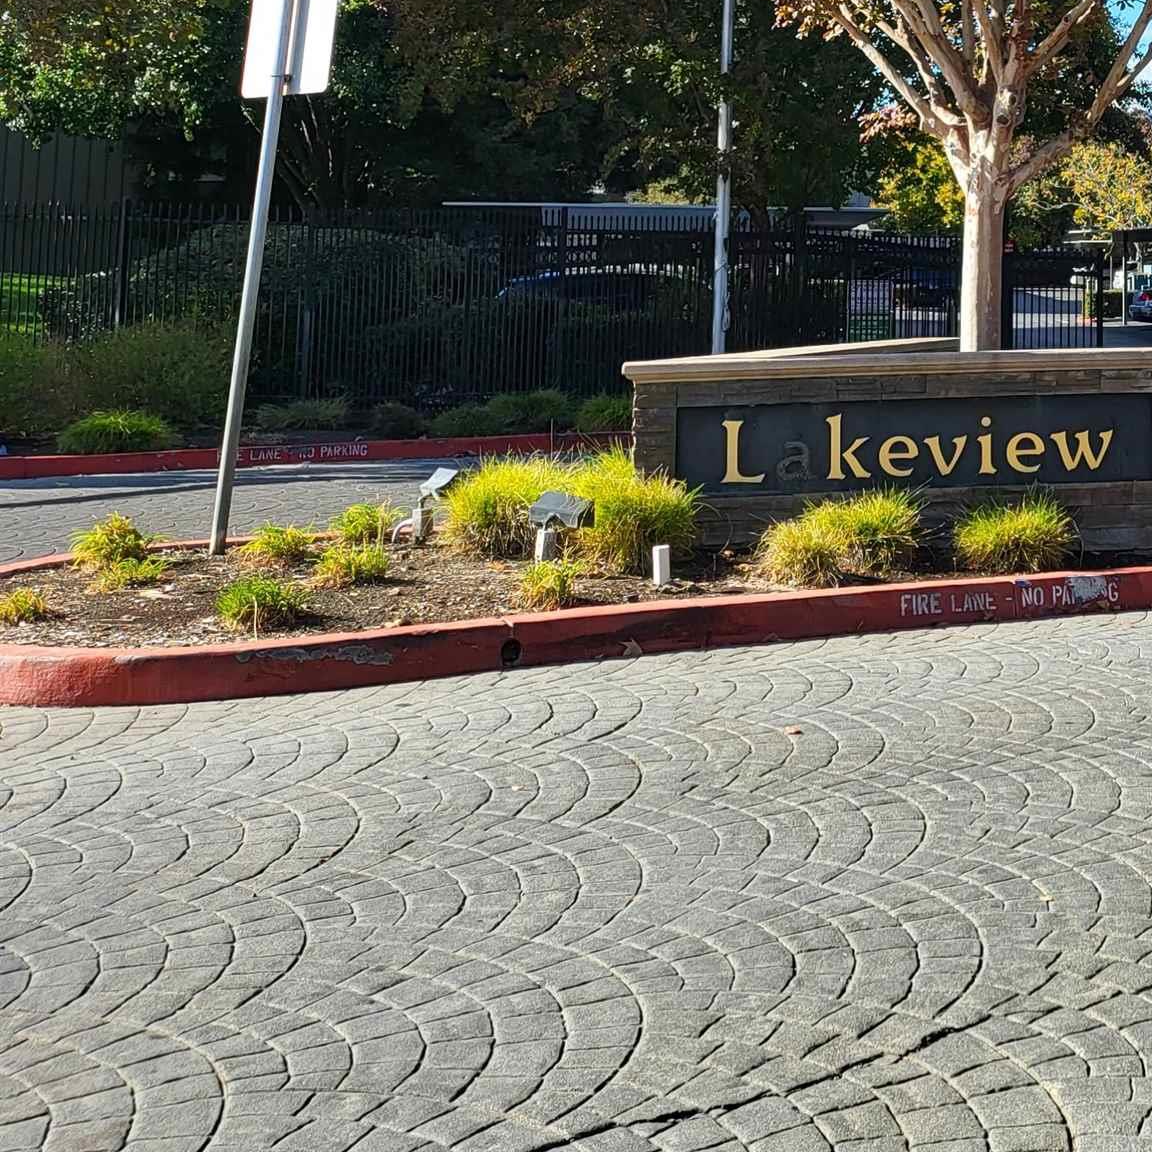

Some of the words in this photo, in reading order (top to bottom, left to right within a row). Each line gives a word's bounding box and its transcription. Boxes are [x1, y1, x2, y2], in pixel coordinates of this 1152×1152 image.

[250, 447, 281, 461] LANE
[320, 444, 368, 458] PARKING
[720, 412, 1113, 485] Lakeview
[901, 593, 942, 617] FIRE
[952, 591, 997, 613] LANE
[1022, 586, 1044, 608] NO
